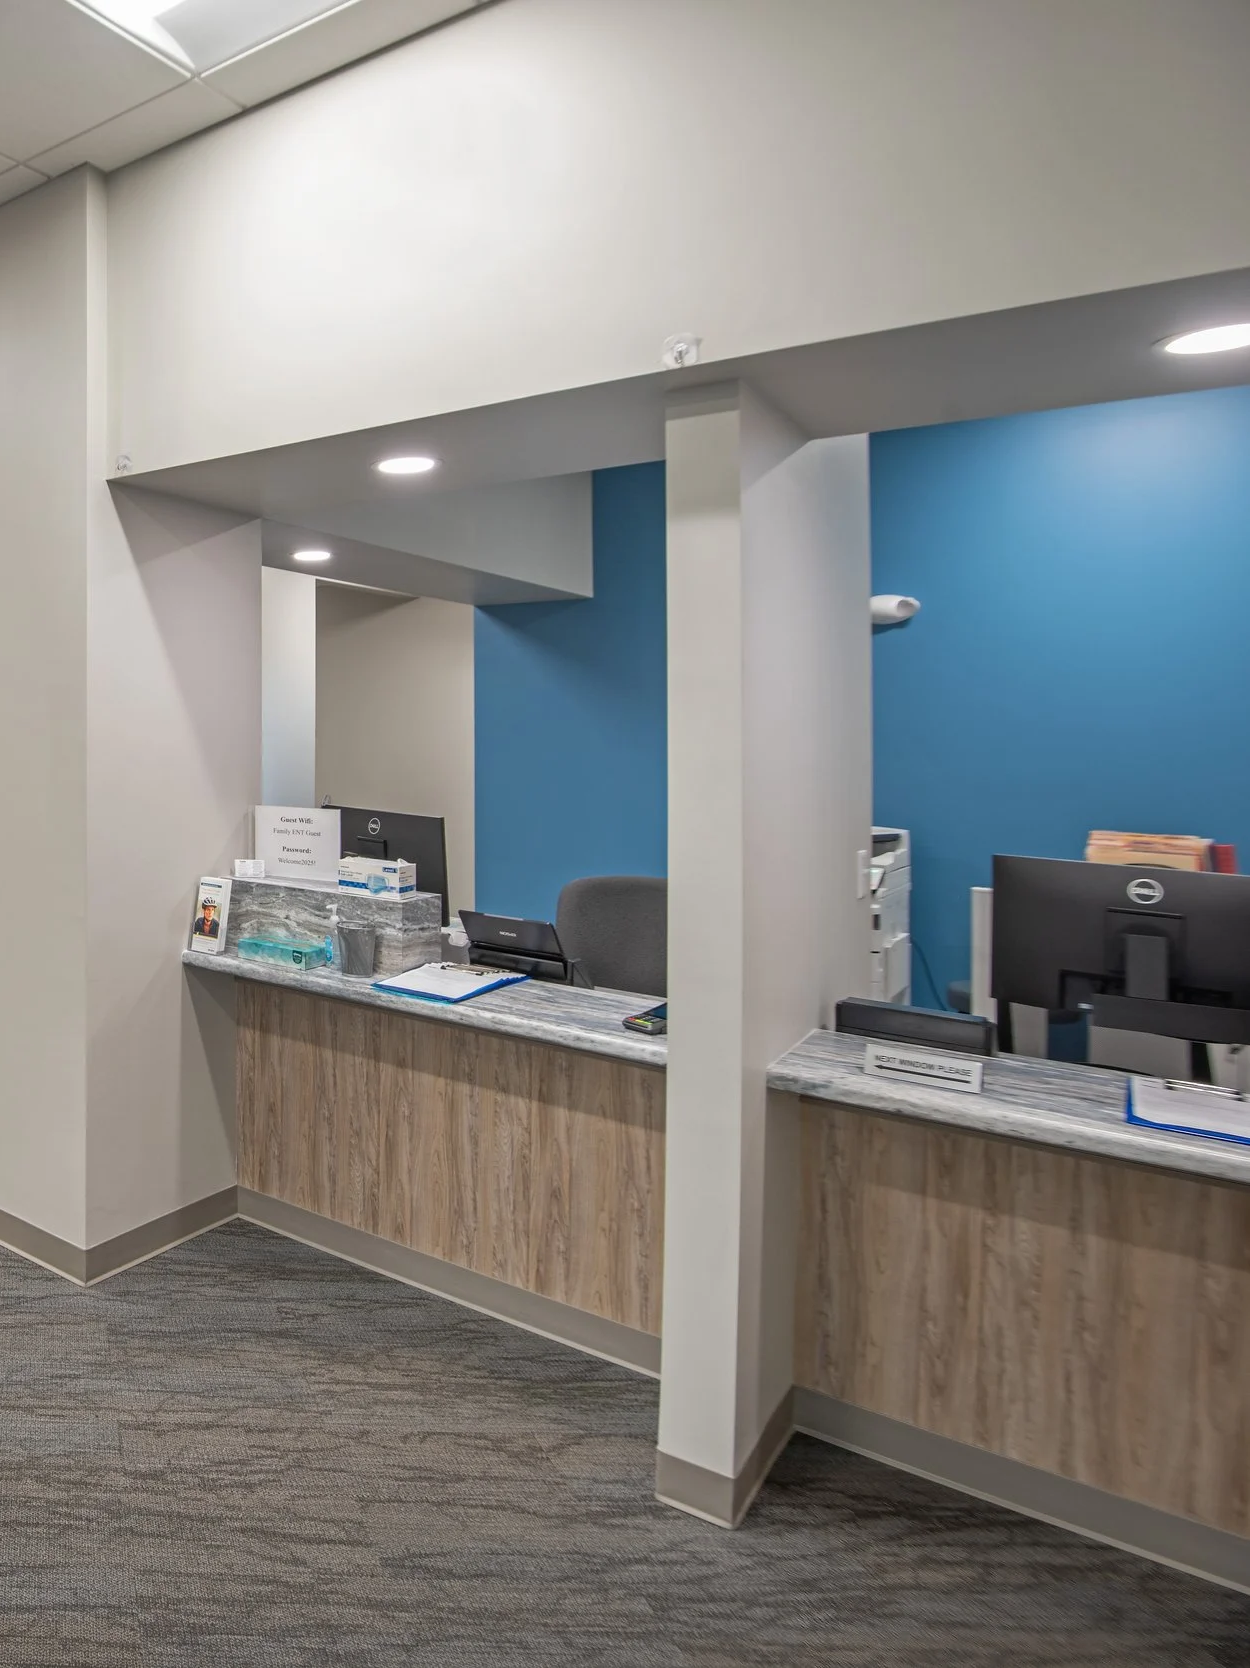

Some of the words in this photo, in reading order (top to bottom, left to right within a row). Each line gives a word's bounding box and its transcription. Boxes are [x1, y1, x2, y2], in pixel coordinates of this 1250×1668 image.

[273, 827, 291, 836] Family
[282, 846, 312, 854] Password:
[874, 1055, 897, 1063] NEXT
[899, 1058, 936, 1070] WINDOW
[937, 1065, 973, 1077] PLEASE
